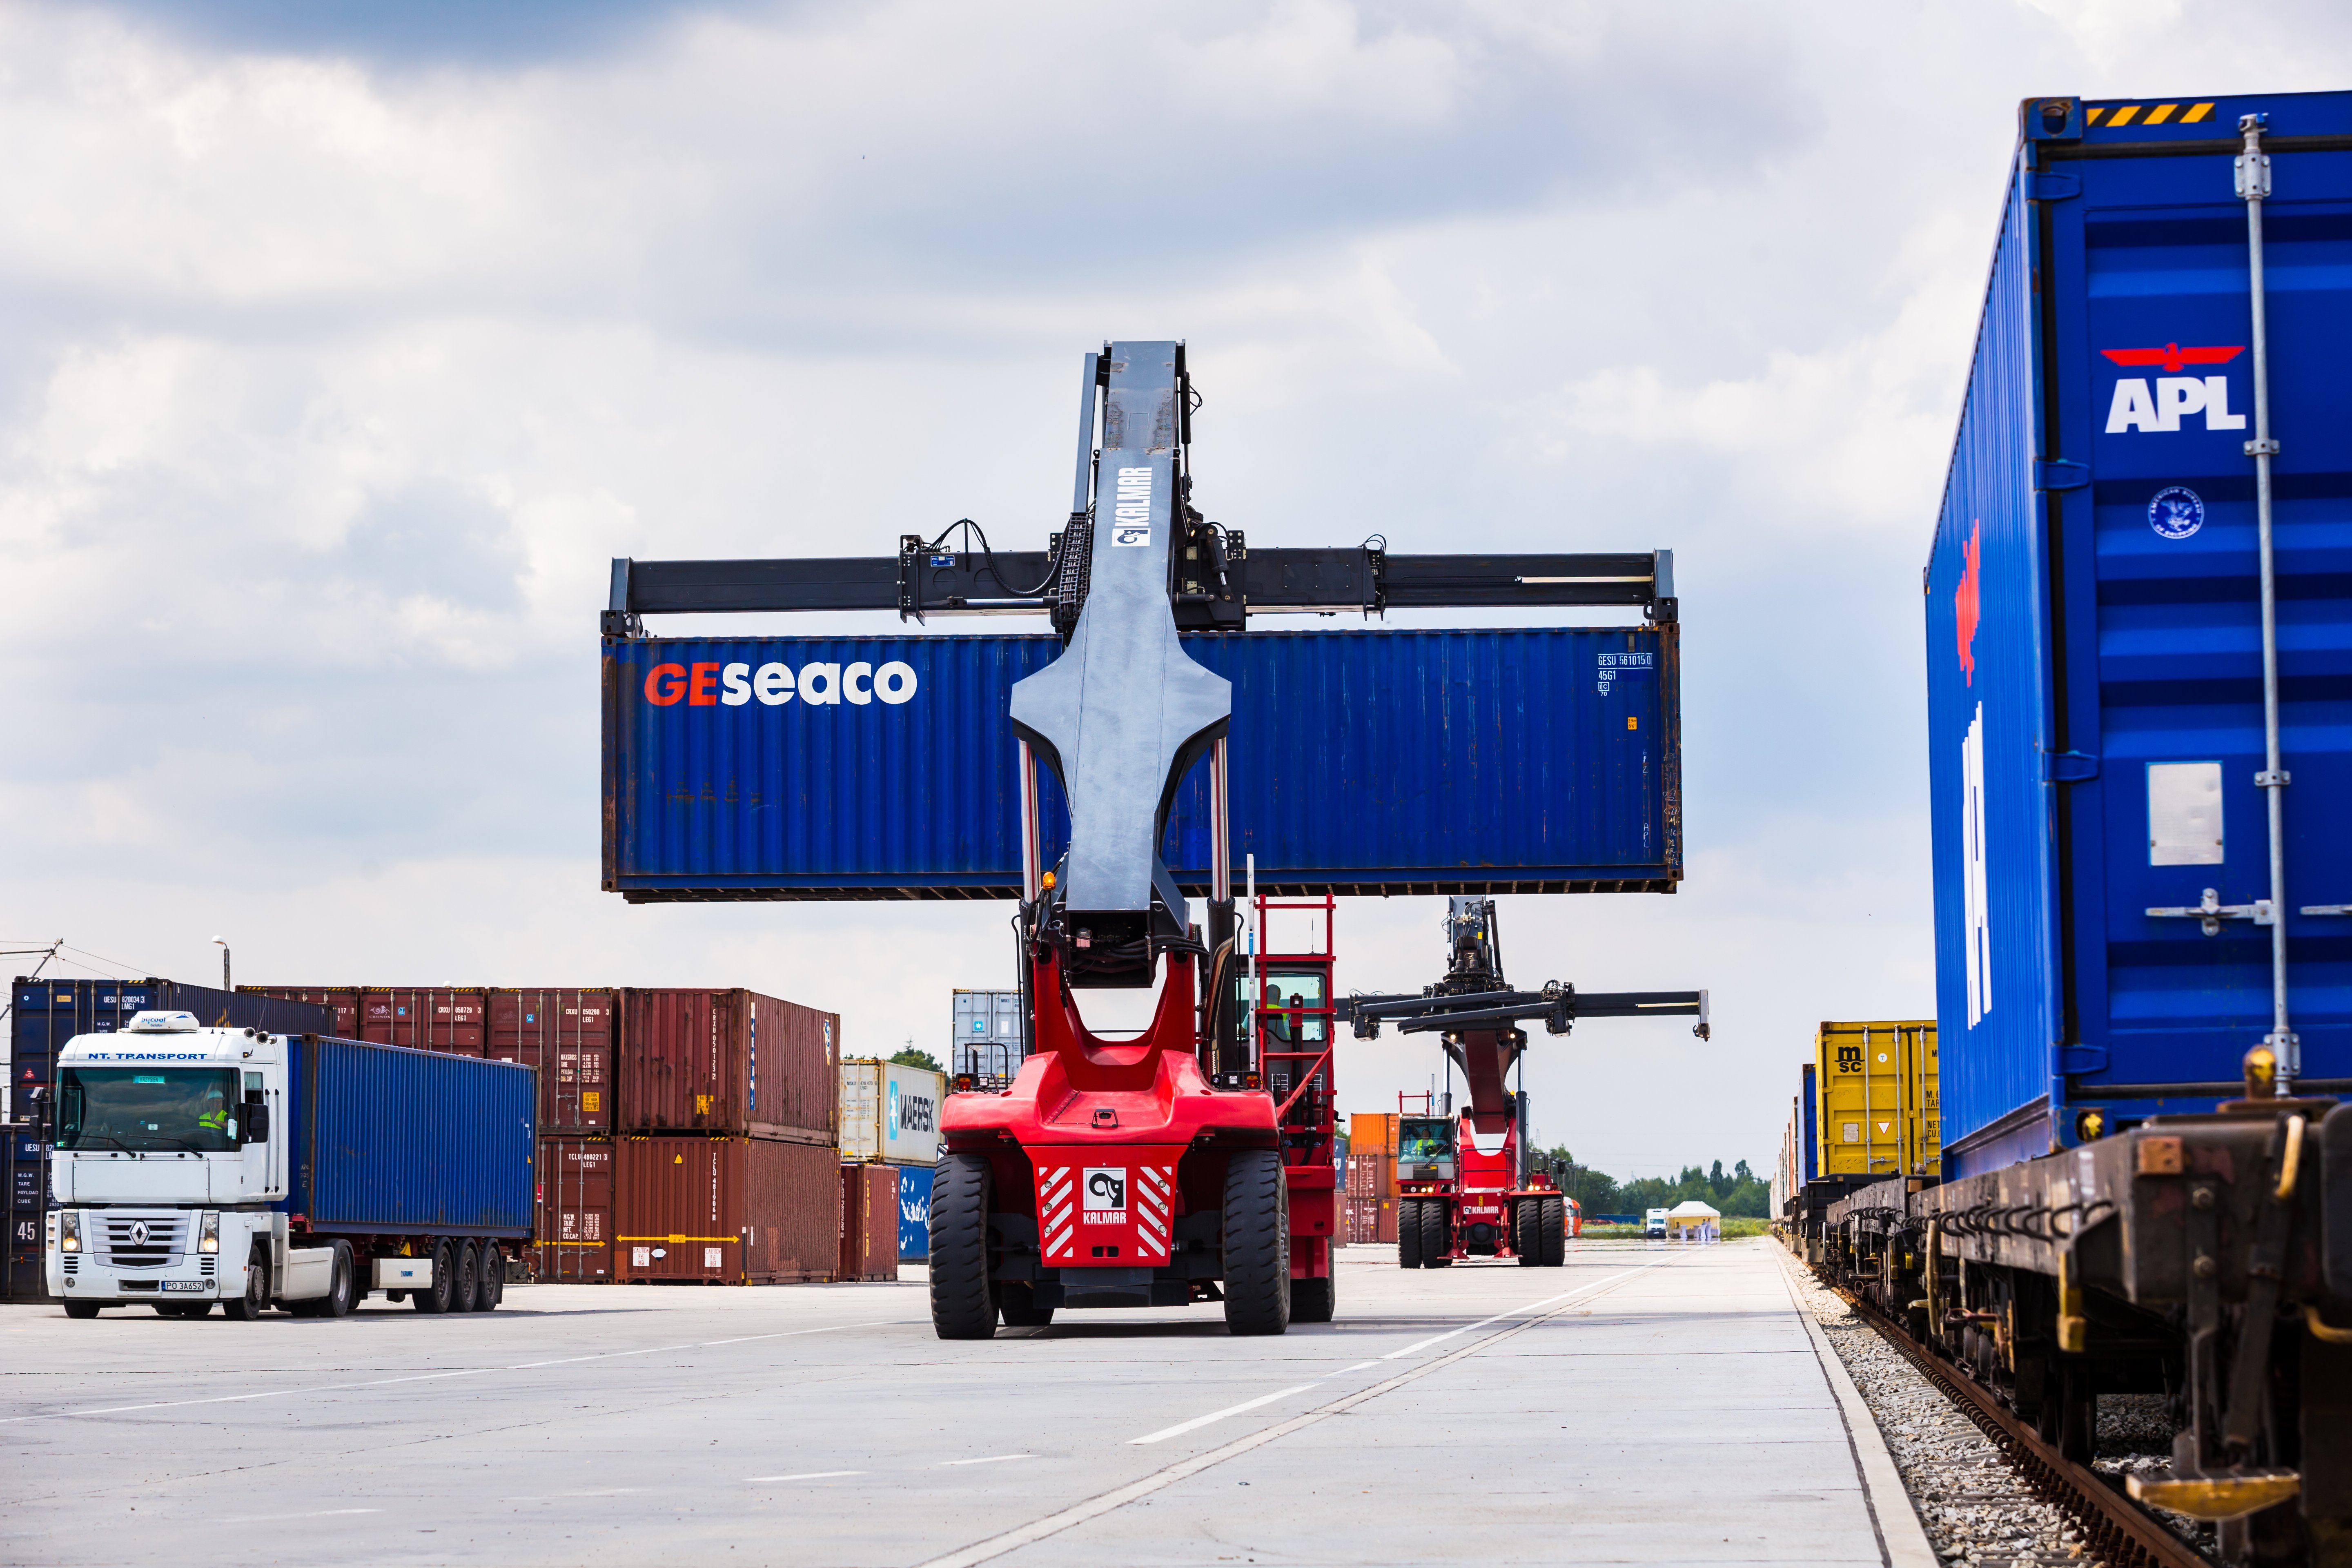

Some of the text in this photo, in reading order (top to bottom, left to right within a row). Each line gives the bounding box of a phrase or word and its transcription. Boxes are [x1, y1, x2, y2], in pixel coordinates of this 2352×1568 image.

[2105, 376, 2246, 433] APL
[1114, 467, 1152, 528] KALMAR
[1598, 655, 1616, 666] GESU
[1599, 670, 1616, 680] 45G1
[1927, 1099, 1939, 1107] TAR
[901, 1094, 934, 1133] MAERSK
[1083, 1212, 1127, 1224] KALMAR
[18, 1222, 35, 1240] 45
